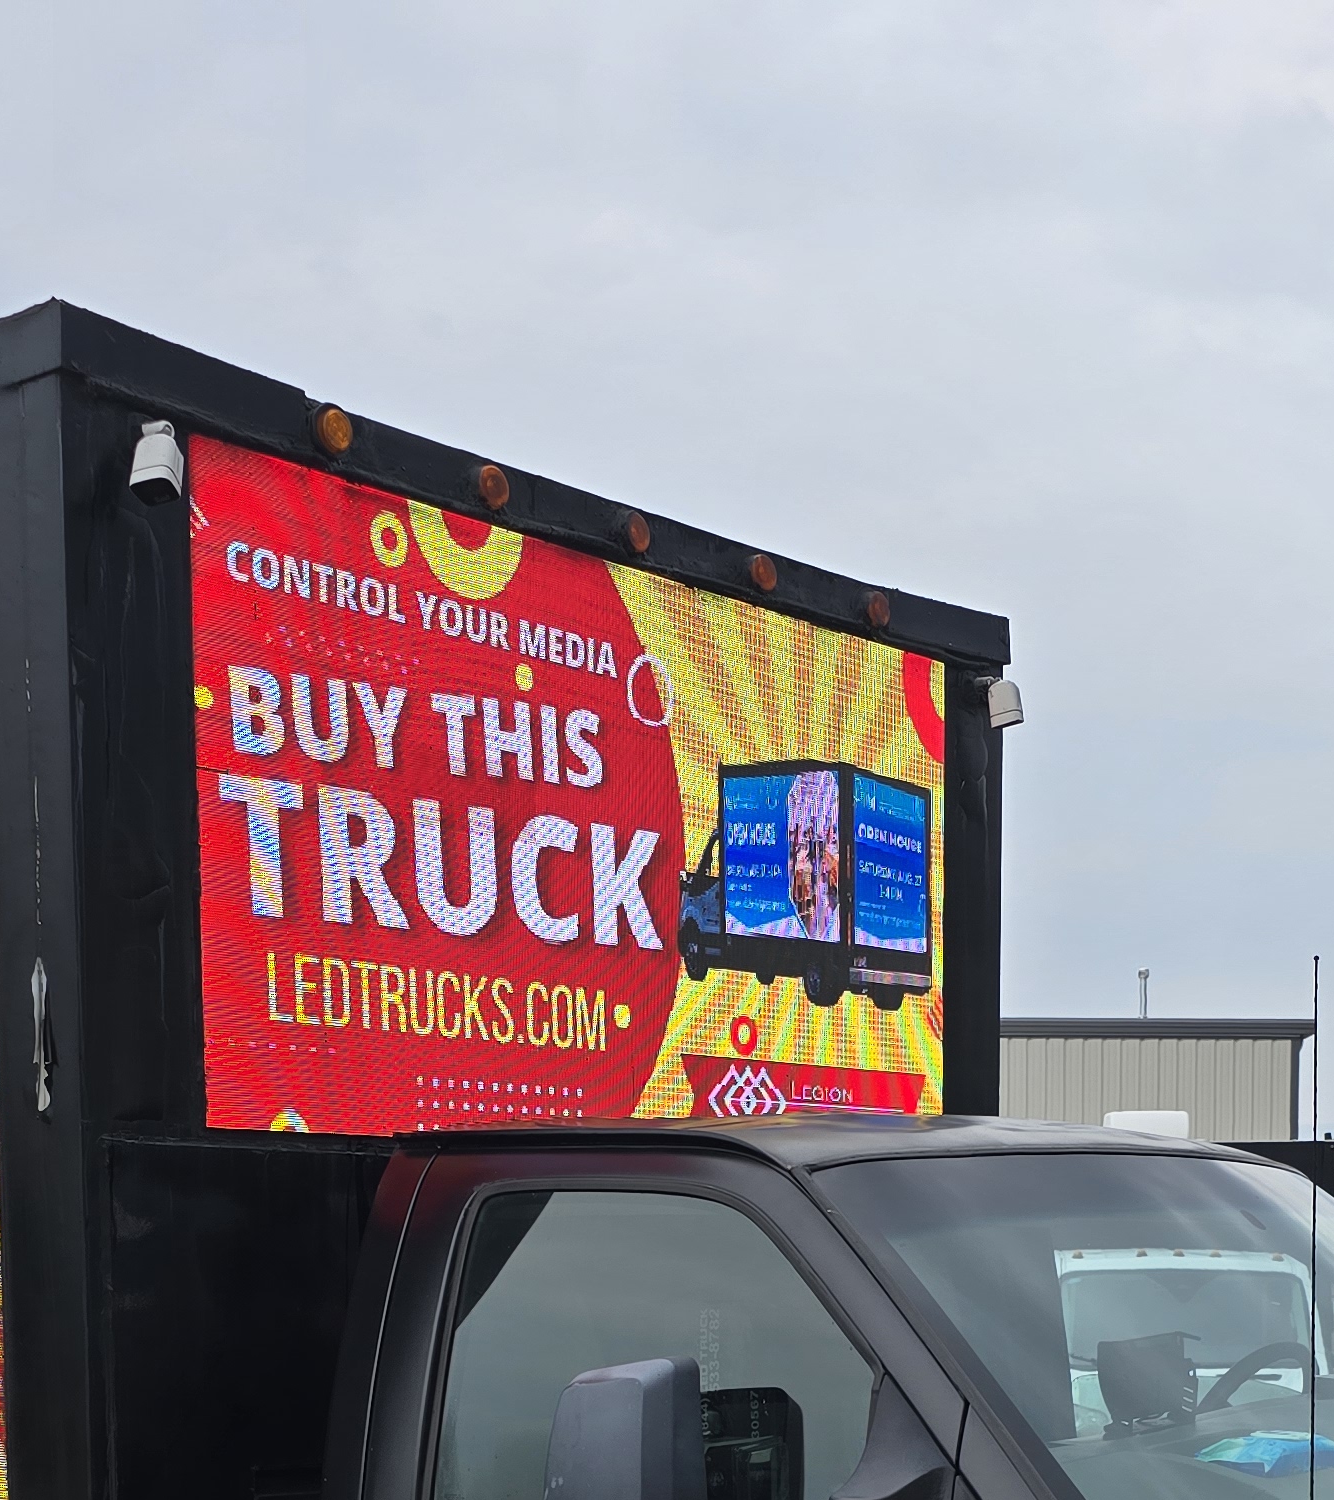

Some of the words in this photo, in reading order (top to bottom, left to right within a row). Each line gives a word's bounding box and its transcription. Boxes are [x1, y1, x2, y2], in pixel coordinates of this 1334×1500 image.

[225, 540, 407, 624] CONTROL
[415, 590, 510, 651] YOUR
[518, 621, 618, 679] MEDIA
[227, 665, 408, 769] BUY
[431, 692, 604, 789] THIS
[218, 773, 664, 951] TRUCK
[267, 951, 607, 1051] LEDTRUCKS.COM
[791, 1080, 854, 1103] LEGION
[700, 1308, 708, 1361] TRUCK
[708, 1308, 720, 1391] 533-8782
